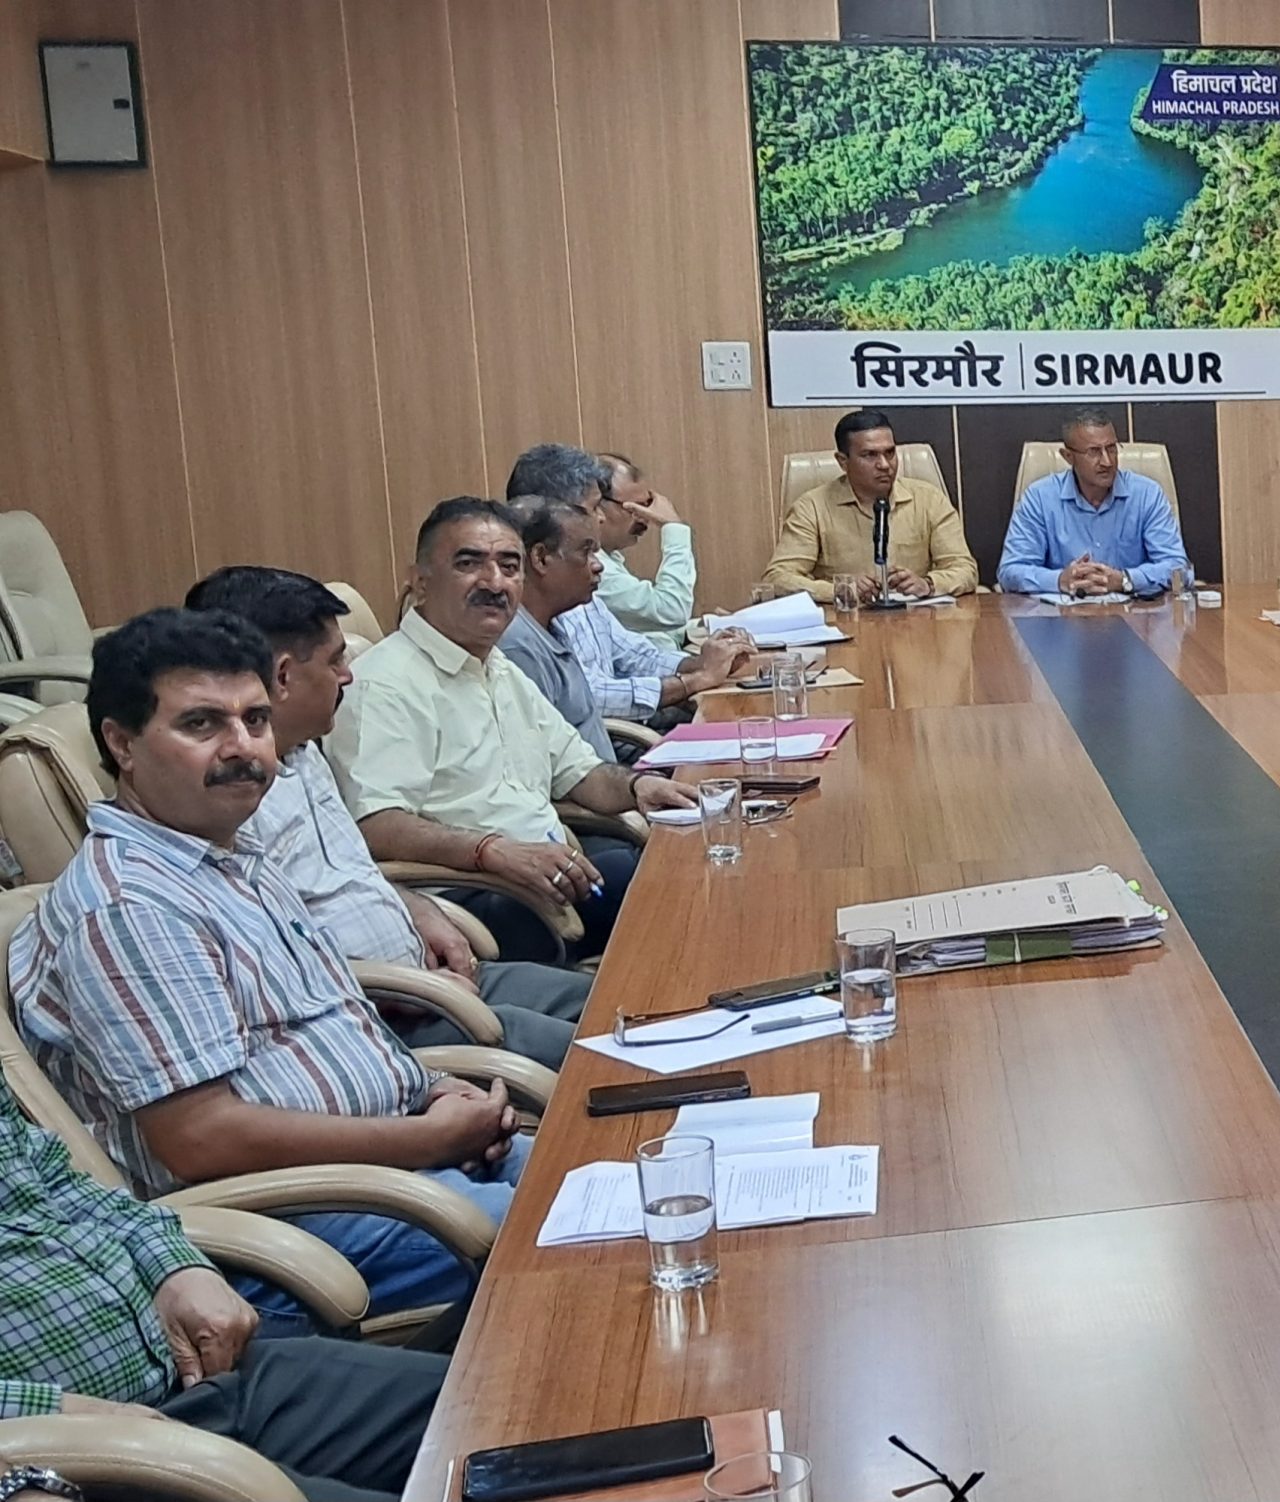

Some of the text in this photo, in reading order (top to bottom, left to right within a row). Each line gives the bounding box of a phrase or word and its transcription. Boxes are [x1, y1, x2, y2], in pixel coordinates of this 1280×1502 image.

[1171, 69, 1278, 95] हिमाचल प्रदेश
[1152, 99, 1280, 116] HIMACHAL PRADESH
[850, 340, 1005, 389] सिरमौर
[1034, 351, 1223, 386] SIRMAUR
